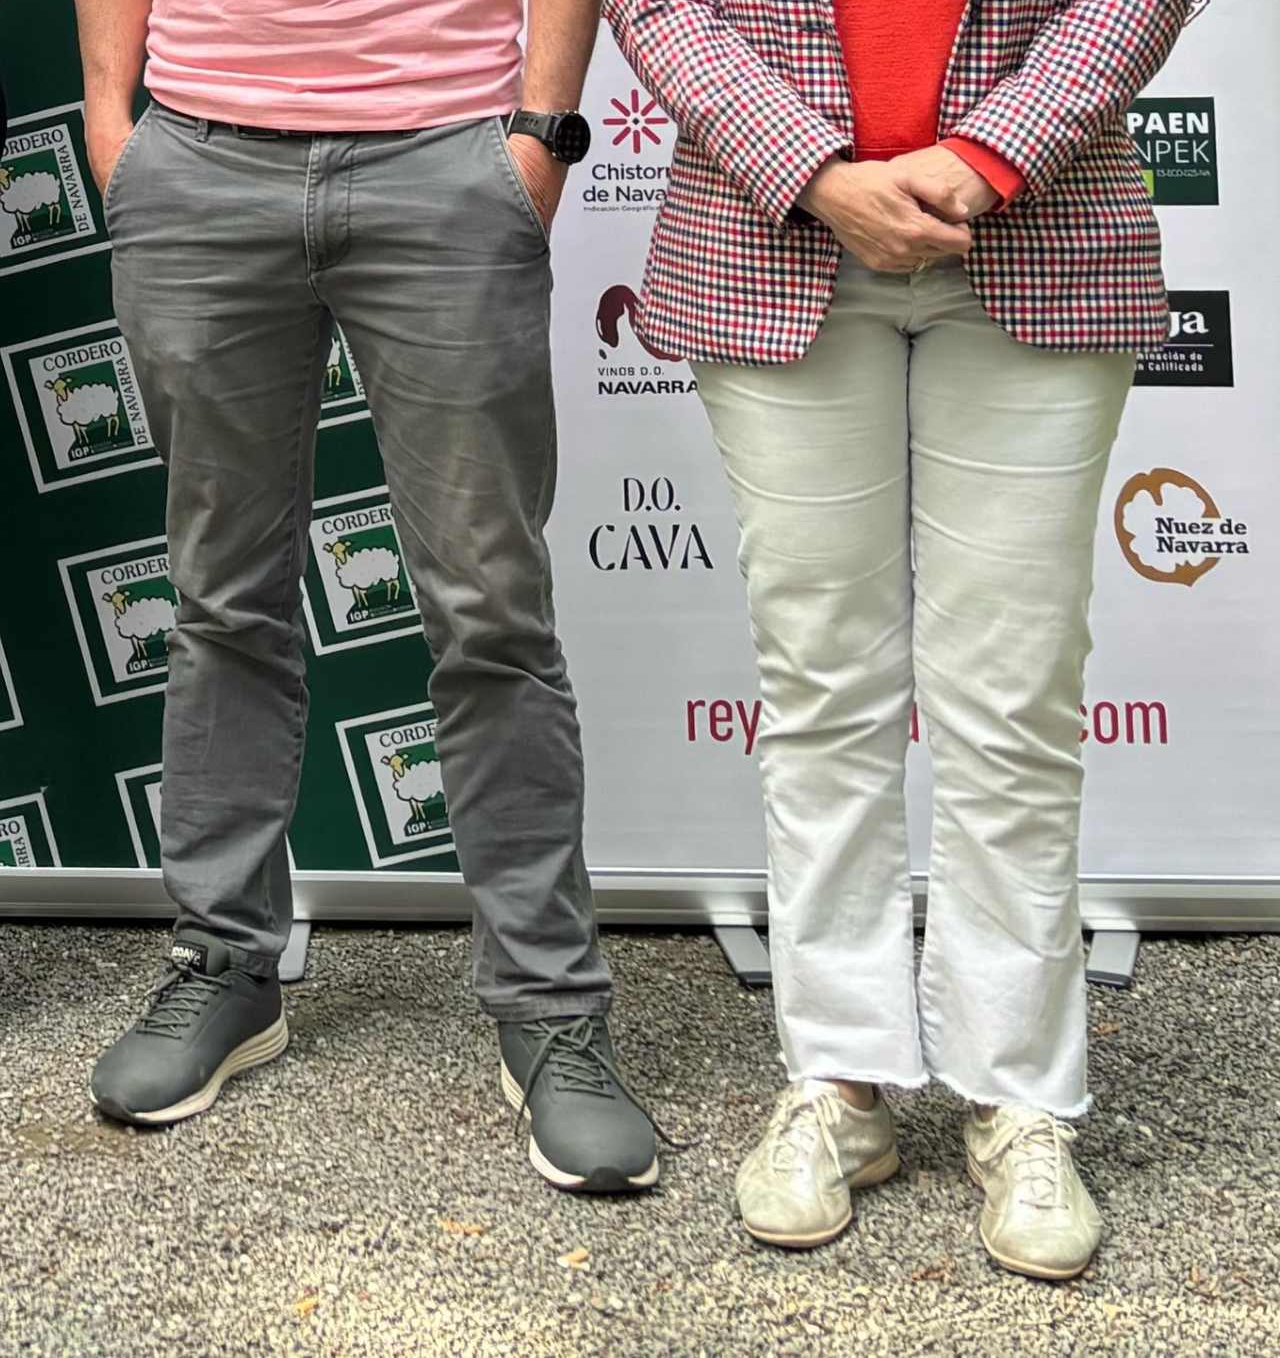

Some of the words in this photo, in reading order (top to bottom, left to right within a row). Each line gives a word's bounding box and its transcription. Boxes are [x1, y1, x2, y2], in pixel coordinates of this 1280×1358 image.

[1126, 112, 1209, 135] PAEN
[2, 128, 64, 157] RDERO
[1134, 140, 1210, 164] NPEK
[57, 144, 84, 210] NAVARRA
[592, 163, 670, 180] Chistorr
[583, 185, 609, 203] de
[616, 185, 667, 202] Nava
[75, 213, 90, 232] DE
[43, 340, 122, 372] CORDERO
[598, 367, 635, 376] VINOS
[114, 356, 143, 422] NAVARRA
[598, 380, 698, 395] NAVARRA
[134, 425, 148, 445] DE
[623, 476, 681, 512] D.O.
[321, 508, 392, 535] CORDER
[1155, 517, 1214, 534] Nuez
[1219, 518, 1247, 535] de
[589, 524, 714, 571] CAVA
[1156, 536, 1249, 554] Navarra
[101, 557, 169, 585] CORDER
[379, 723, 436, 748] CORDE
